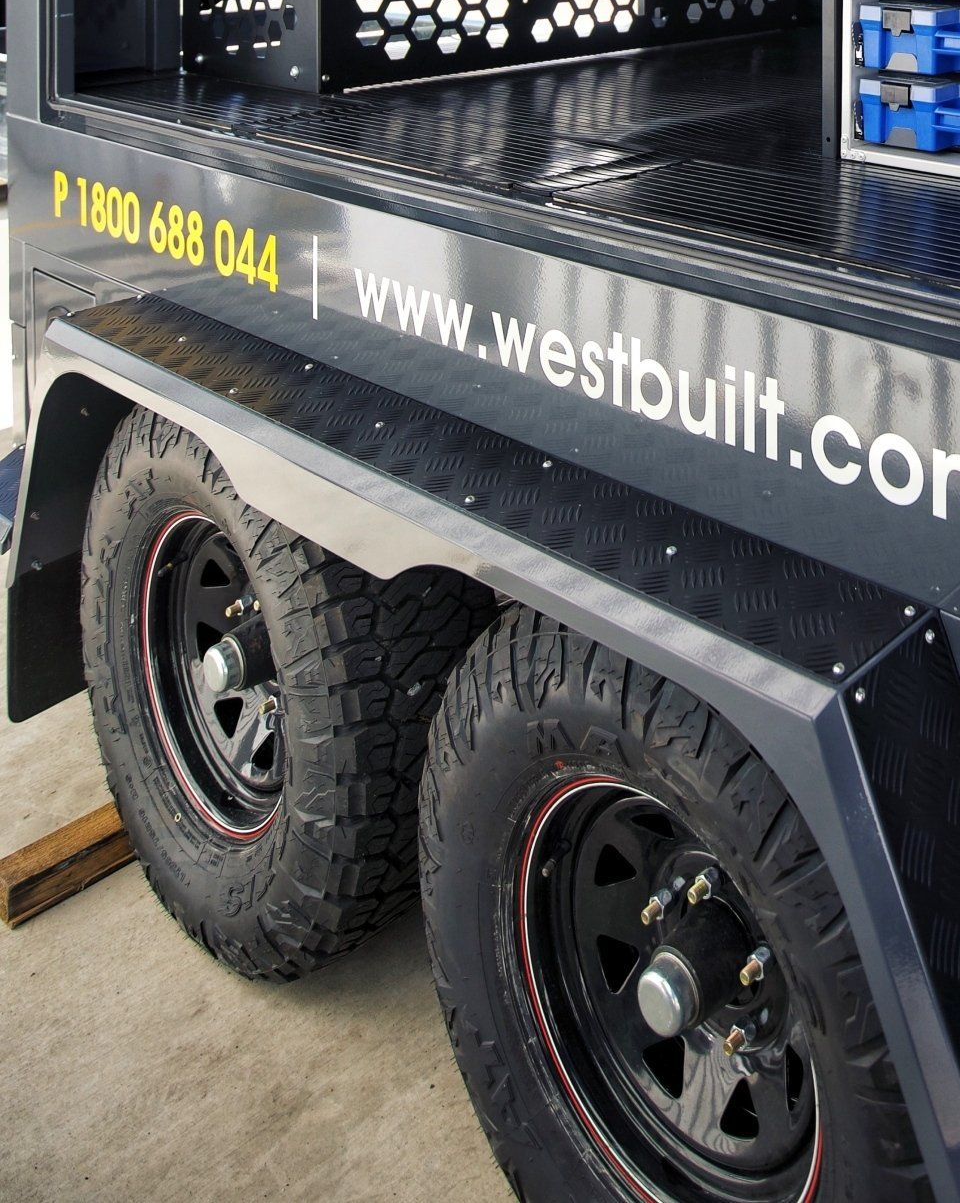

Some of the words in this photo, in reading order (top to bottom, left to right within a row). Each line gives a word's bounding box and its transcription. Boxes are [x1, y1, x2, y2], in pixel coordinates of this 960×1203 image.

[53, 170, 69, 218] P
[76, 177, 140, 244] 1800
[149, 201, 205, 266] 688
[215, 219, 279, 292] 044
